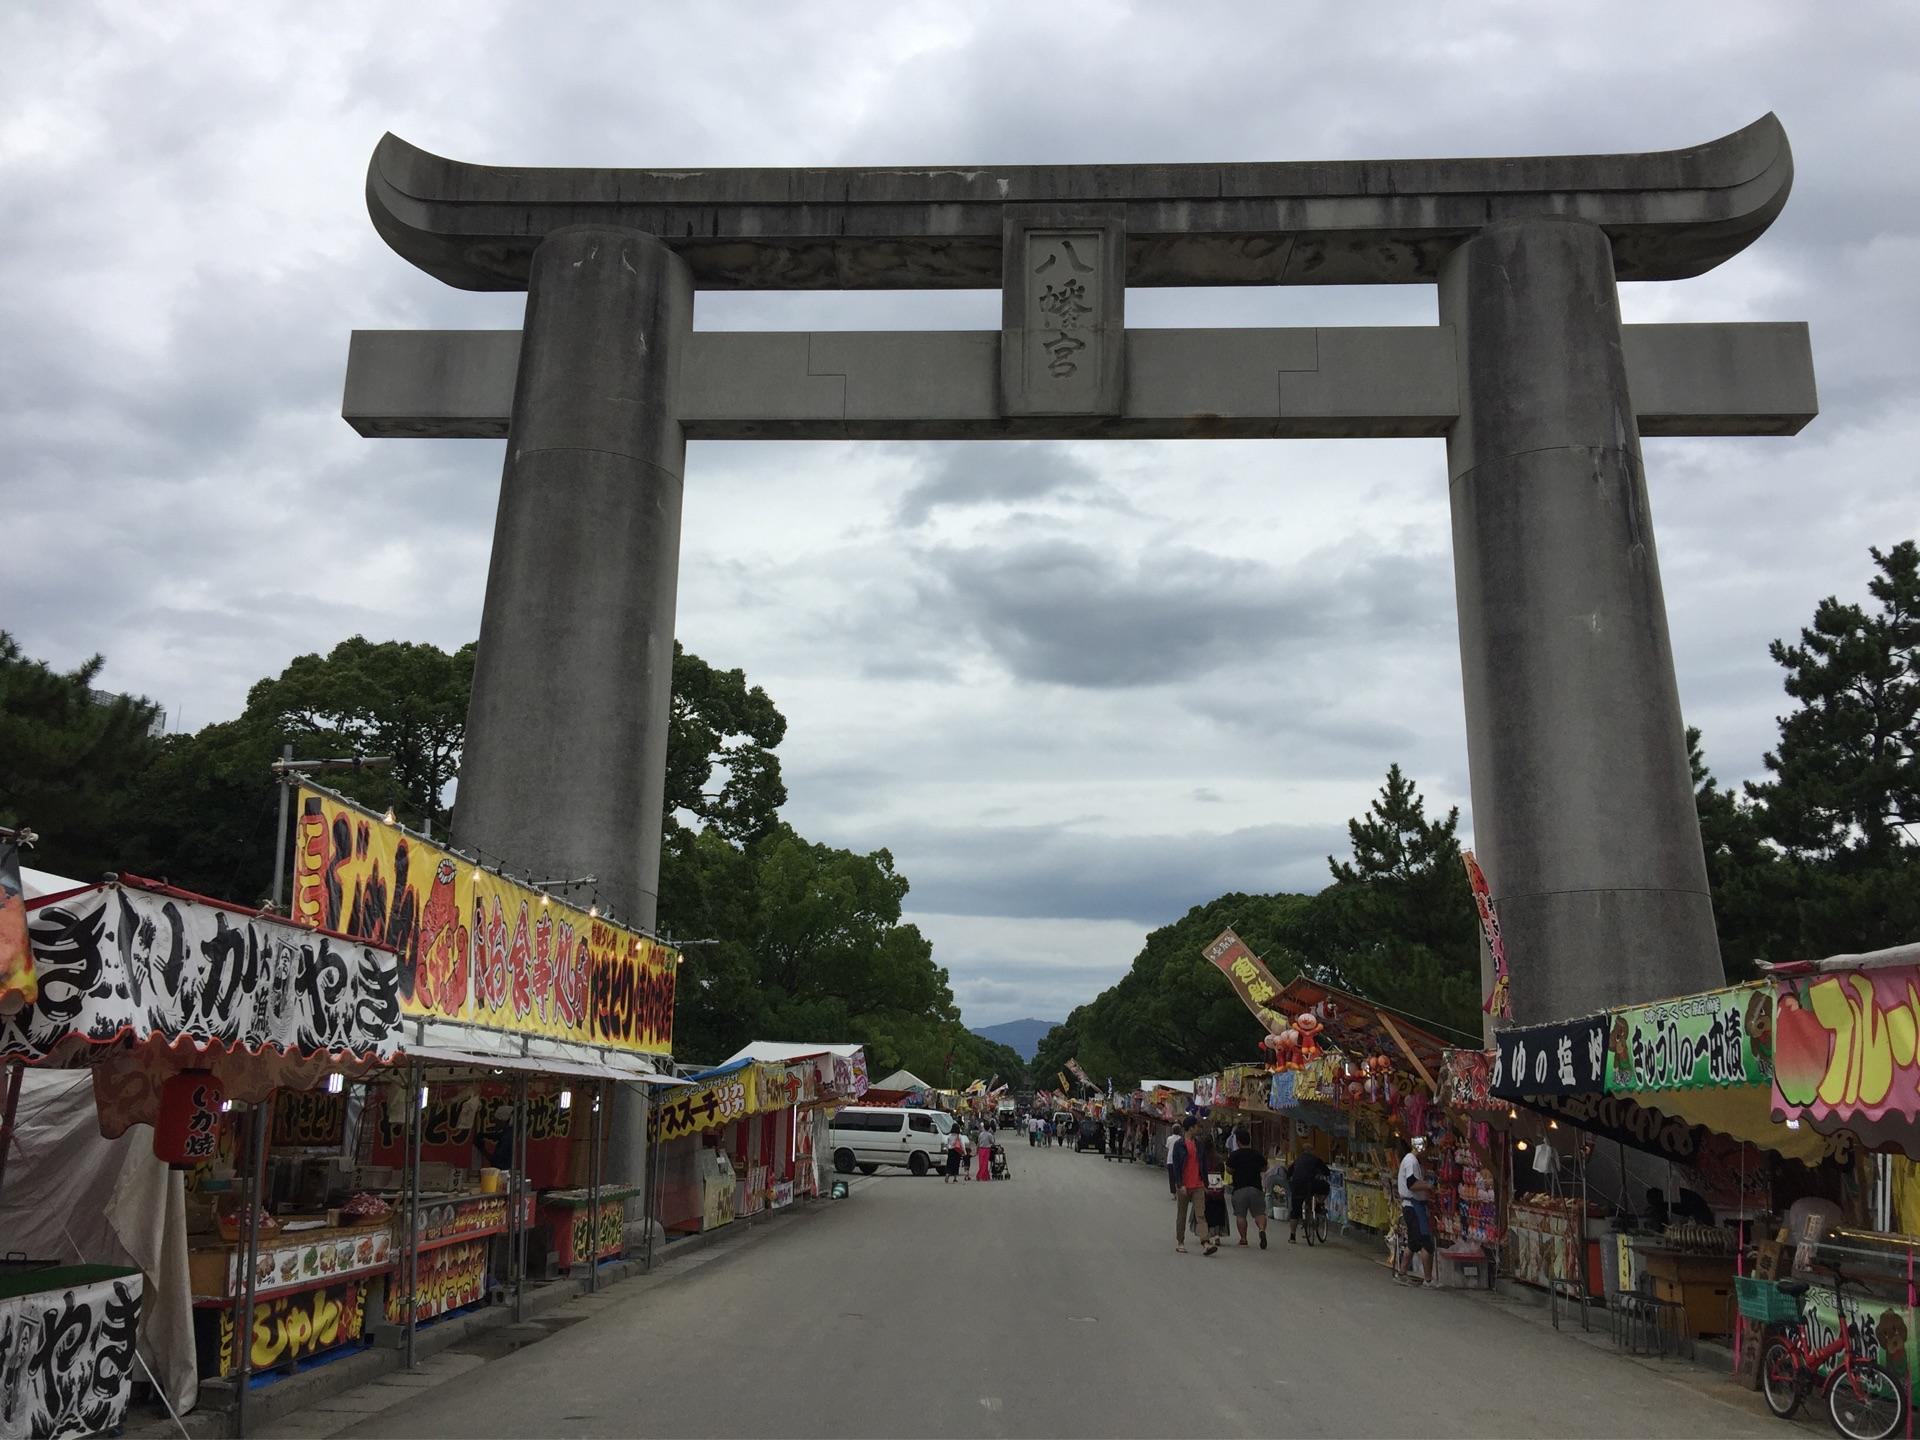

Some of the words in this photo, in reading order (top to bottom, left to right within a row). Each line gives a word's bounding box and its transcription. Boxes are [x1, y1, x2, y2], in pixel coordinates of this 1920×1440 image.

[1034, 240, 1095, 379] 八幡宮
[486, 894, 576, 1030] お食事処
[1632, 1007, 1747, 1087] きゅうりの一本漬
[185, 1085, 220, 1157] いか焼
